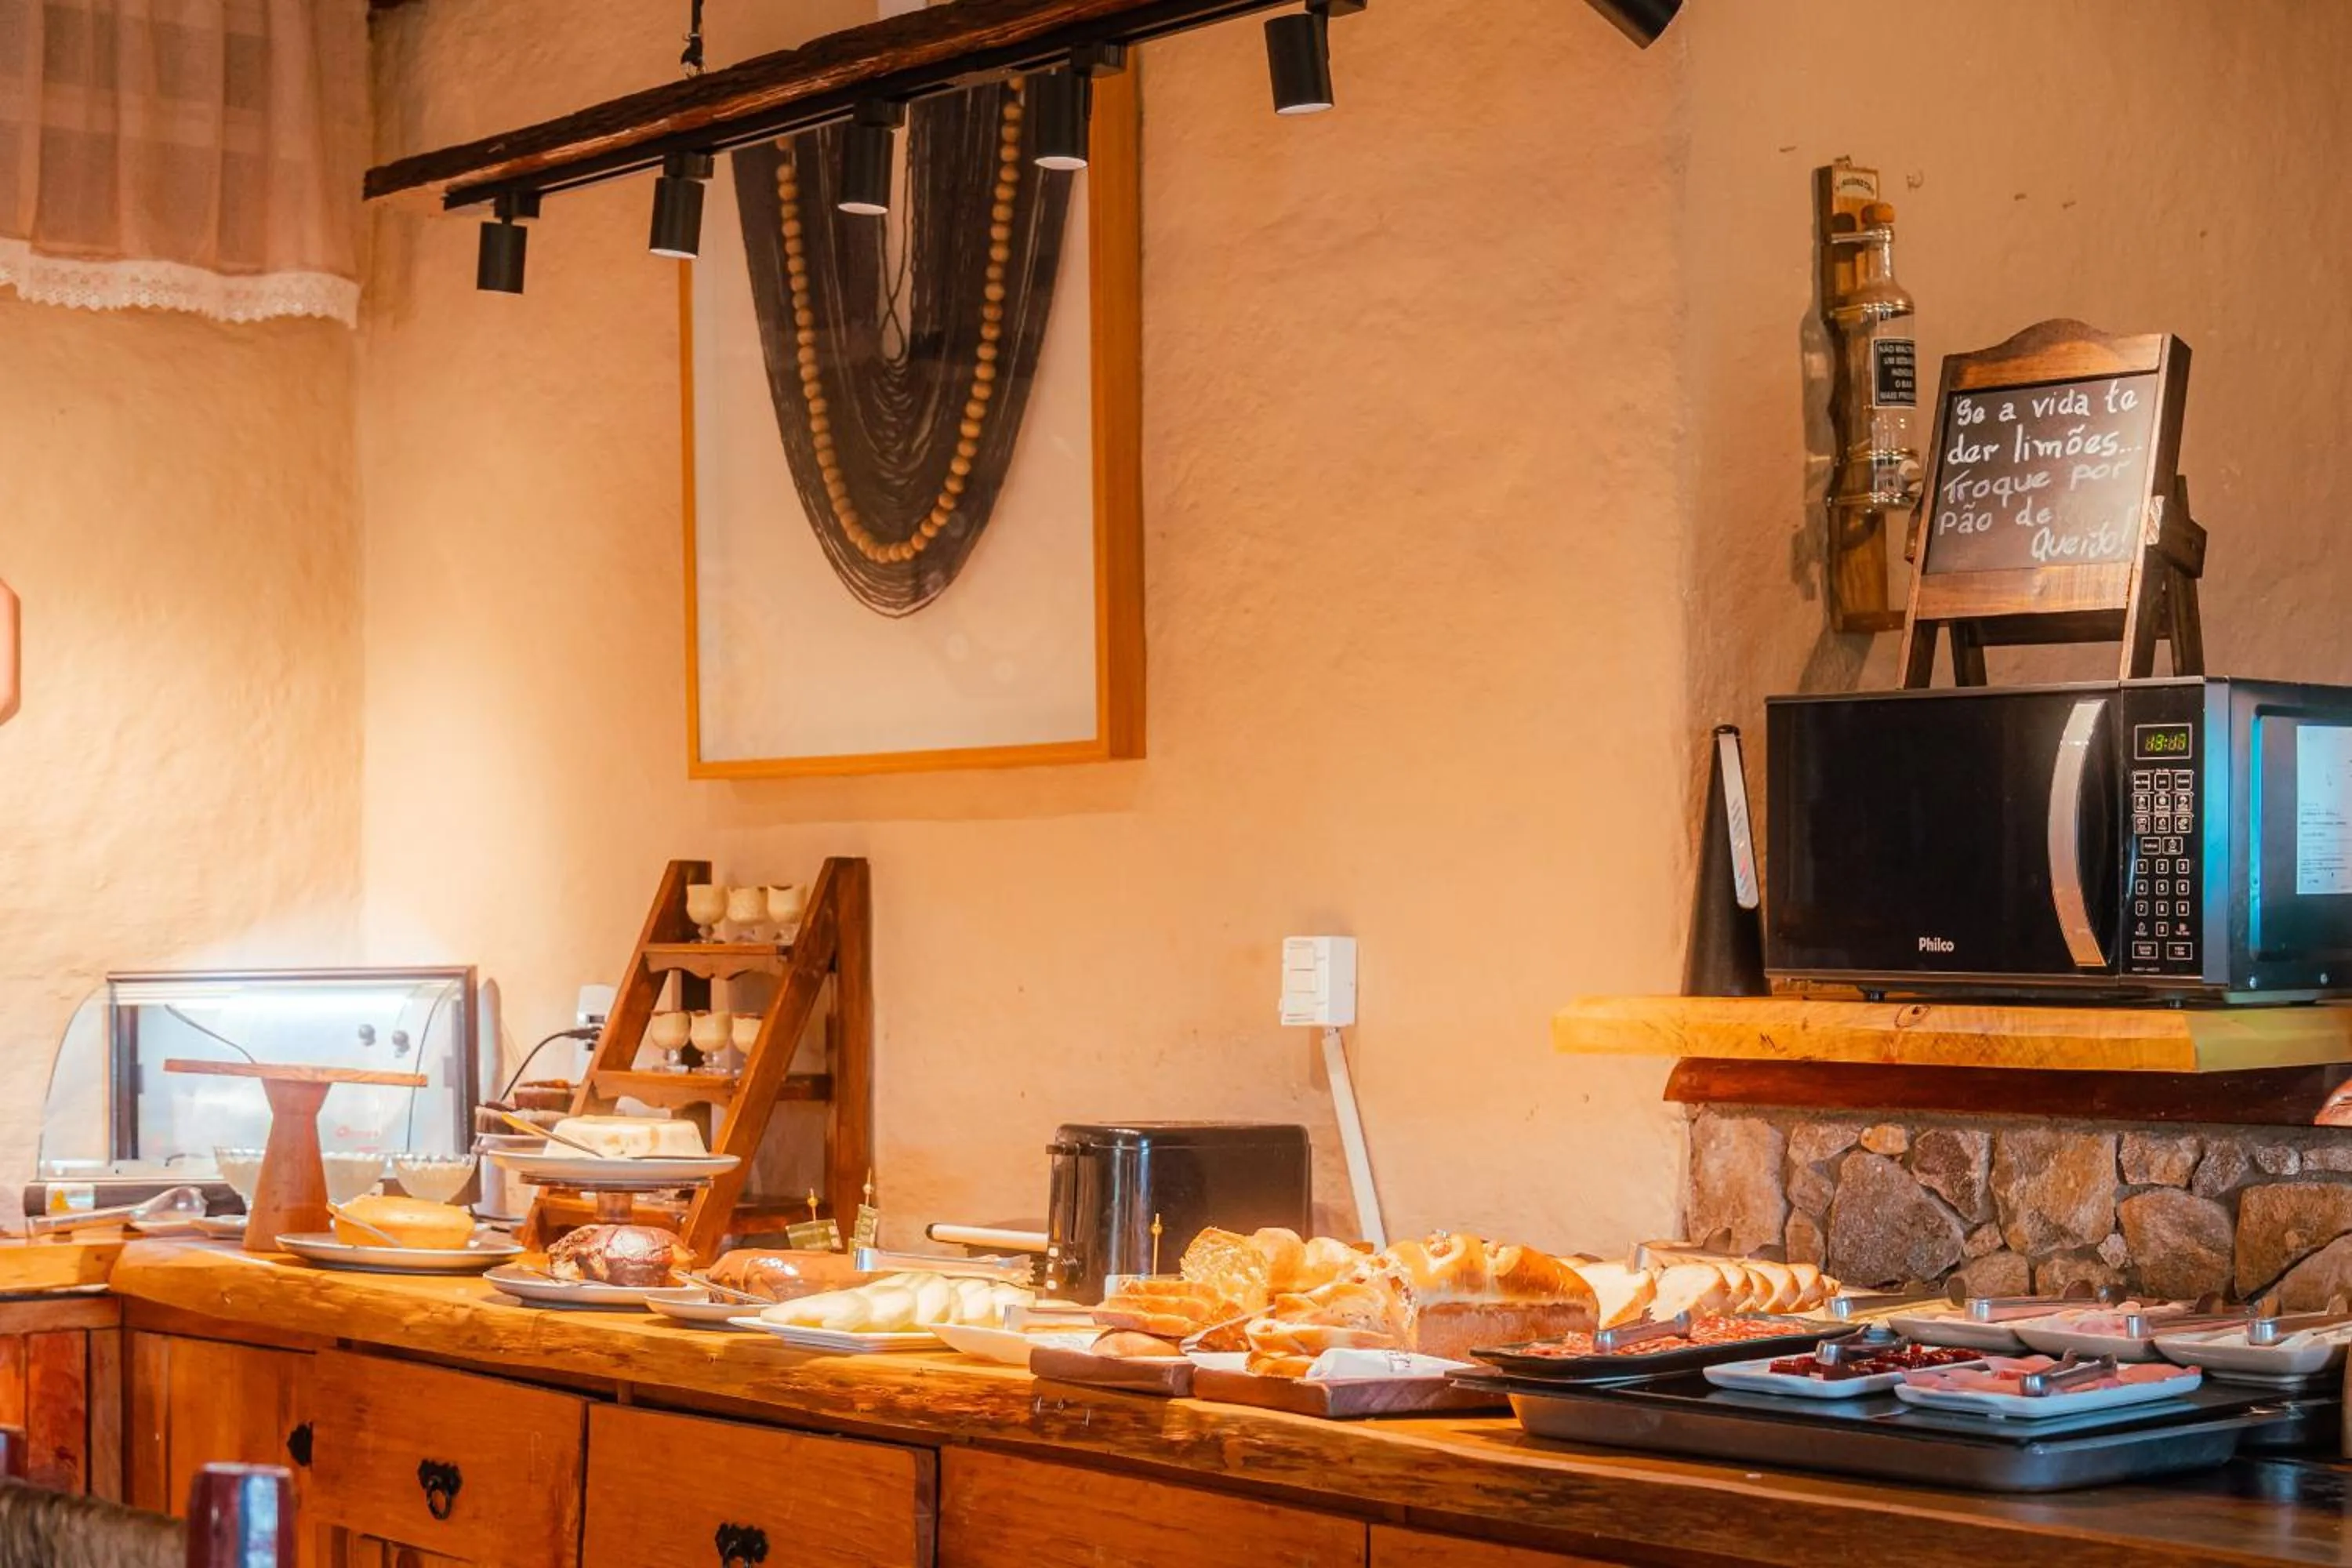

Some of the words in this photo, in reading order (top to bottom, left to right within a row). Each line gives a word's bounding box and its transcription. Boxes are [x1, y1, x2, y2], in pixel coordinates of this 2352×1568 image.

[1998, 402, 2016, 422] a
[2031, 389, 2090, 417] vida
[2105, 379, 2138, 413] te
[1947, 433, 2000, 465] der
[2070, 460, 2132, 492] por
[2015, 495, 2053, 527] de
[1918, 937, 1955, 952] Philco
